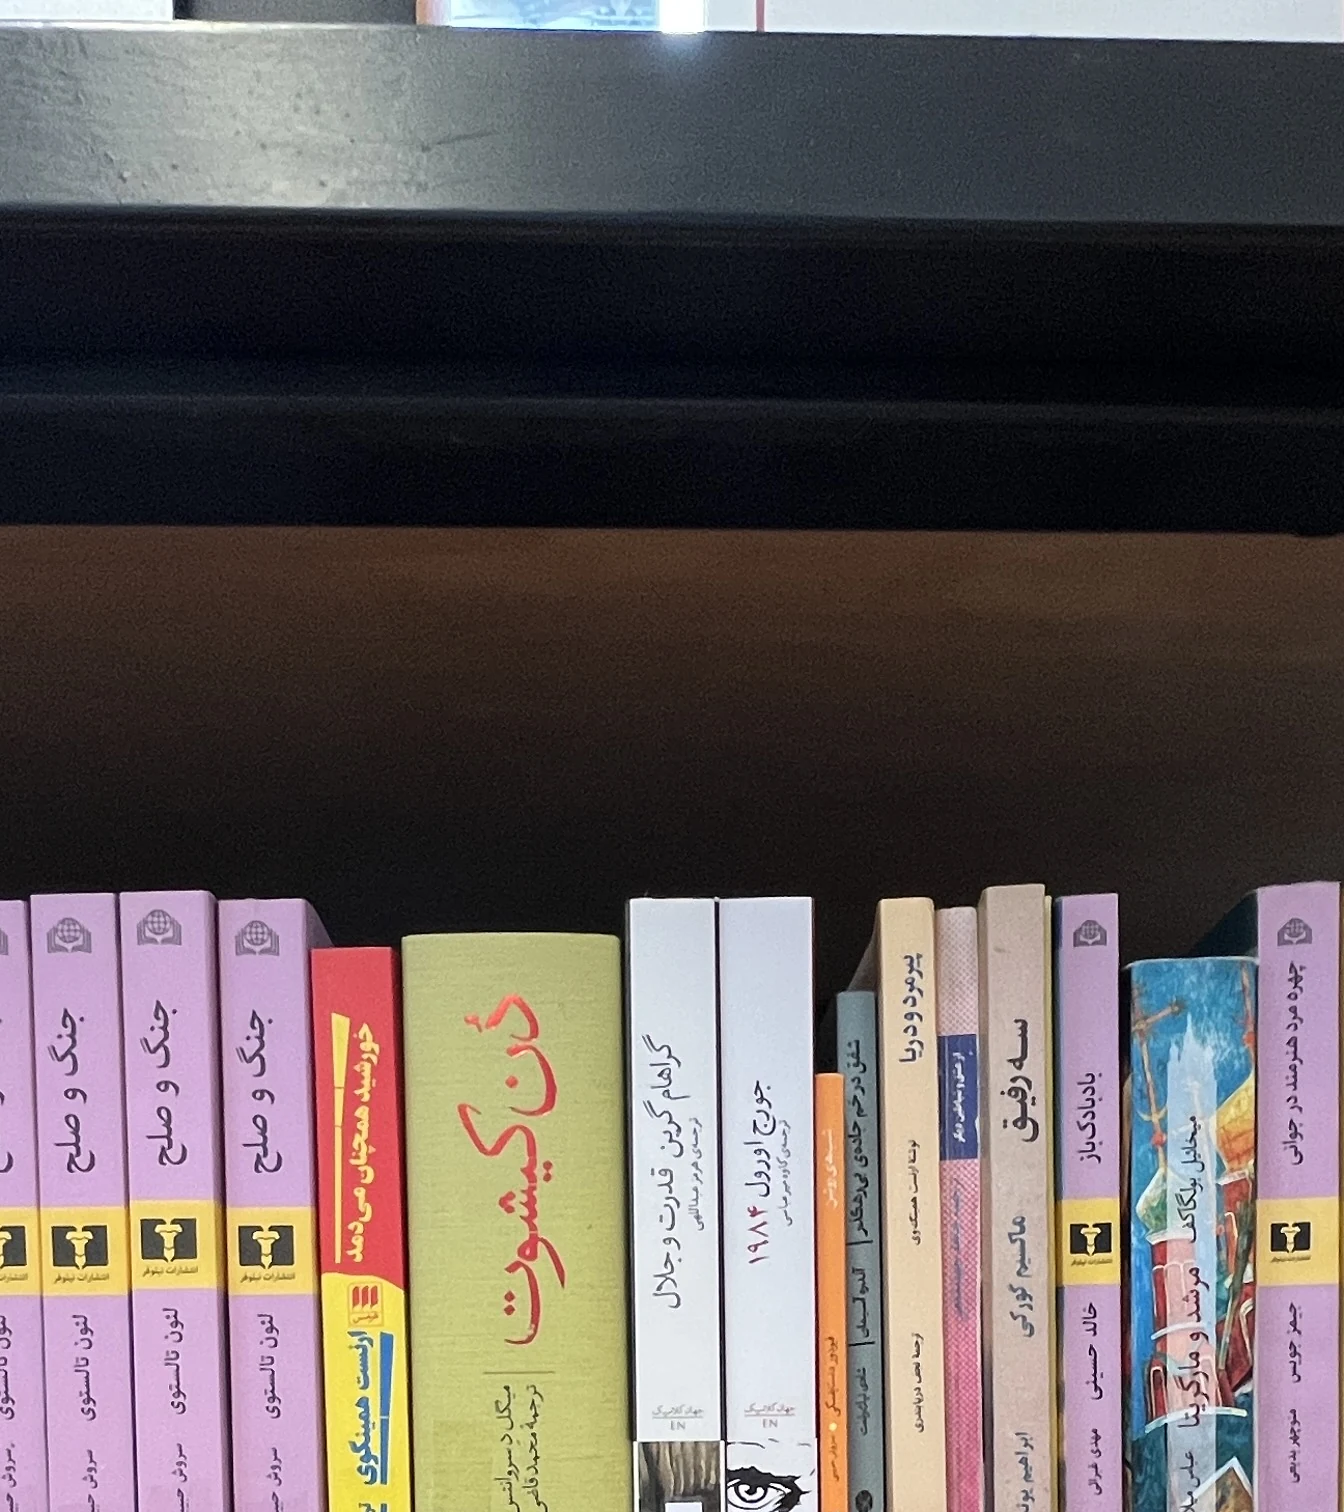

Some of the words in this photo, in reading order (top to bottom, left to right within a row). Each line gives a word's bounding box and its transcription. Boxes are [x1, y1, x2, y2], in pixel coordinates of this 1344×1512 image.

[1285, 961, 1304, 1000] چهره
[46, 1008, 85, 1076] جنگ
[136, 1000, 177, 1069] جنگ
[235, 1010, 274, 1078] جنگ
[1010, 1018, 1029, 1070] سه
[1289, 1004, 1304, 1031] مرد
[155, 1080, 177, 1096] و
[642, 1034, 690, 1100] گراهام
[1284, 1036, 1301, 1091] هنرمند
[66, 1087, 86, 1102] و
[253, 1089, 274, 1105] و
[751, 1081, 777, 1135] جورج
[1000, 1075, 1040, 1143] رفیق
[1287, 1095, 1303, 1113] در
[55, 1114, 95, 1173] صلح
[146, 1106, 186, 1166] صلح
[244, 1115, 283, 1174] صلح
[643, 1098, 684, 1158] گرین
[1284, 1120, 1304, 1166] جوانی
[745, 1141, 771, 1197] اورول
[457, 1102, 566, 1346] کیشوت
[651, 1167, 681, 1230] قدرت
[663, 1238, 681, 1250] و
[746, 1206, 770, 1265] ۱۹۸۴
[653, 1252, 682, 1310] جلال
[1178, 1266, 1211, 1323] مرشد
[1191, 1331, 1209, 1341] و
[1178, 1352, 1210, 1429] مارگریتا
